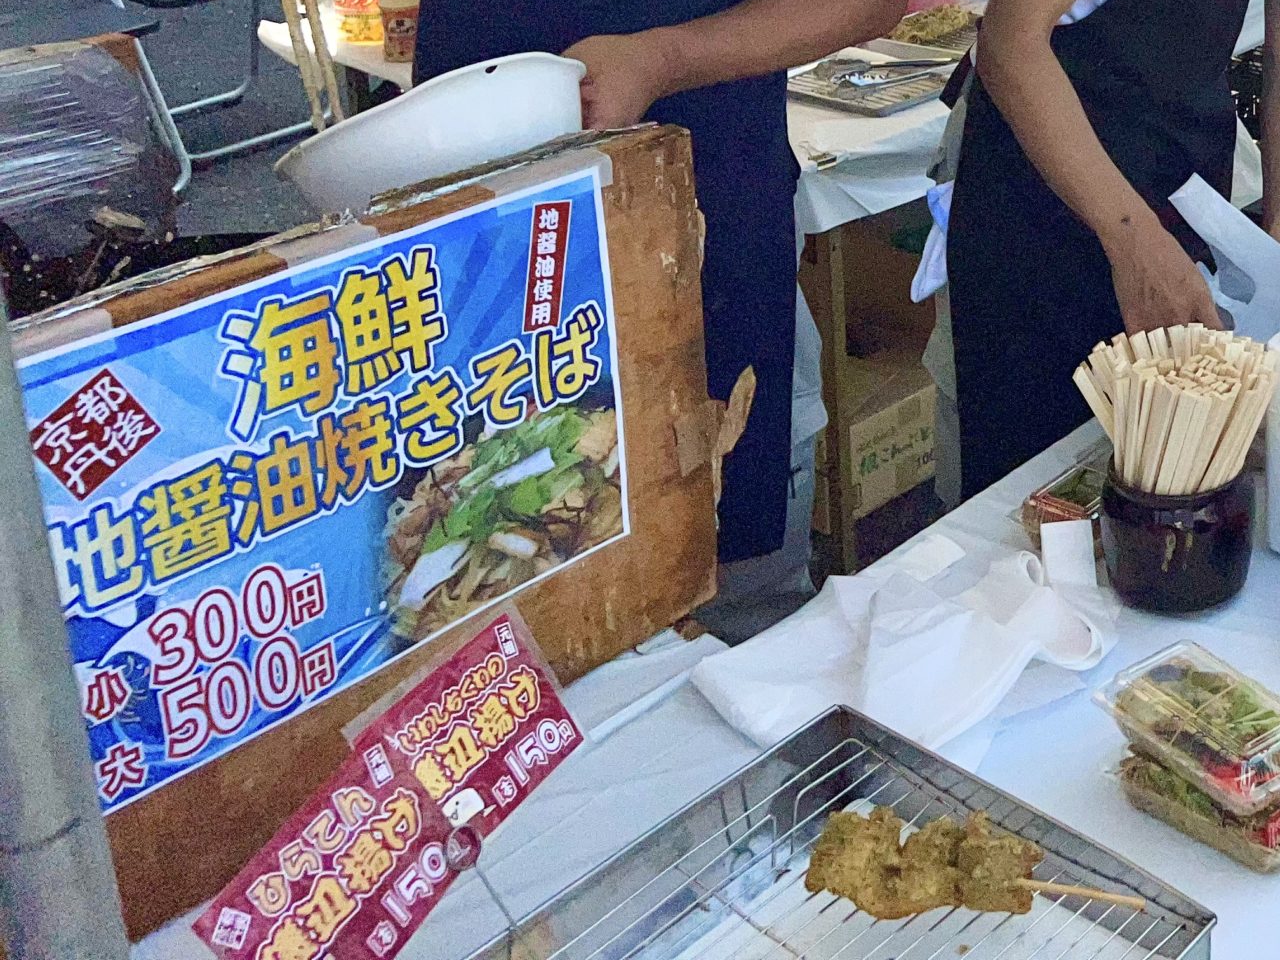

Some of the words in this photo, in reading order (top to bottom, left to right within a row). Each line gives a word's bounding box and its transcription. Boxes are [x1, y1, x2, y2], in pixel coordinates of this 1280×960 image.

[222, 248, 445, 442] 海鮮
[531, 207, 560, 326] 地醤油使用
[50, 304, 601, 610] 地醤油焼きそば
[86, 671, 130, 720] 小
[148, 565, 326, 686] 300円
[101, 744, 146, 797] 大
[157, 637, 337, 759] 500円
